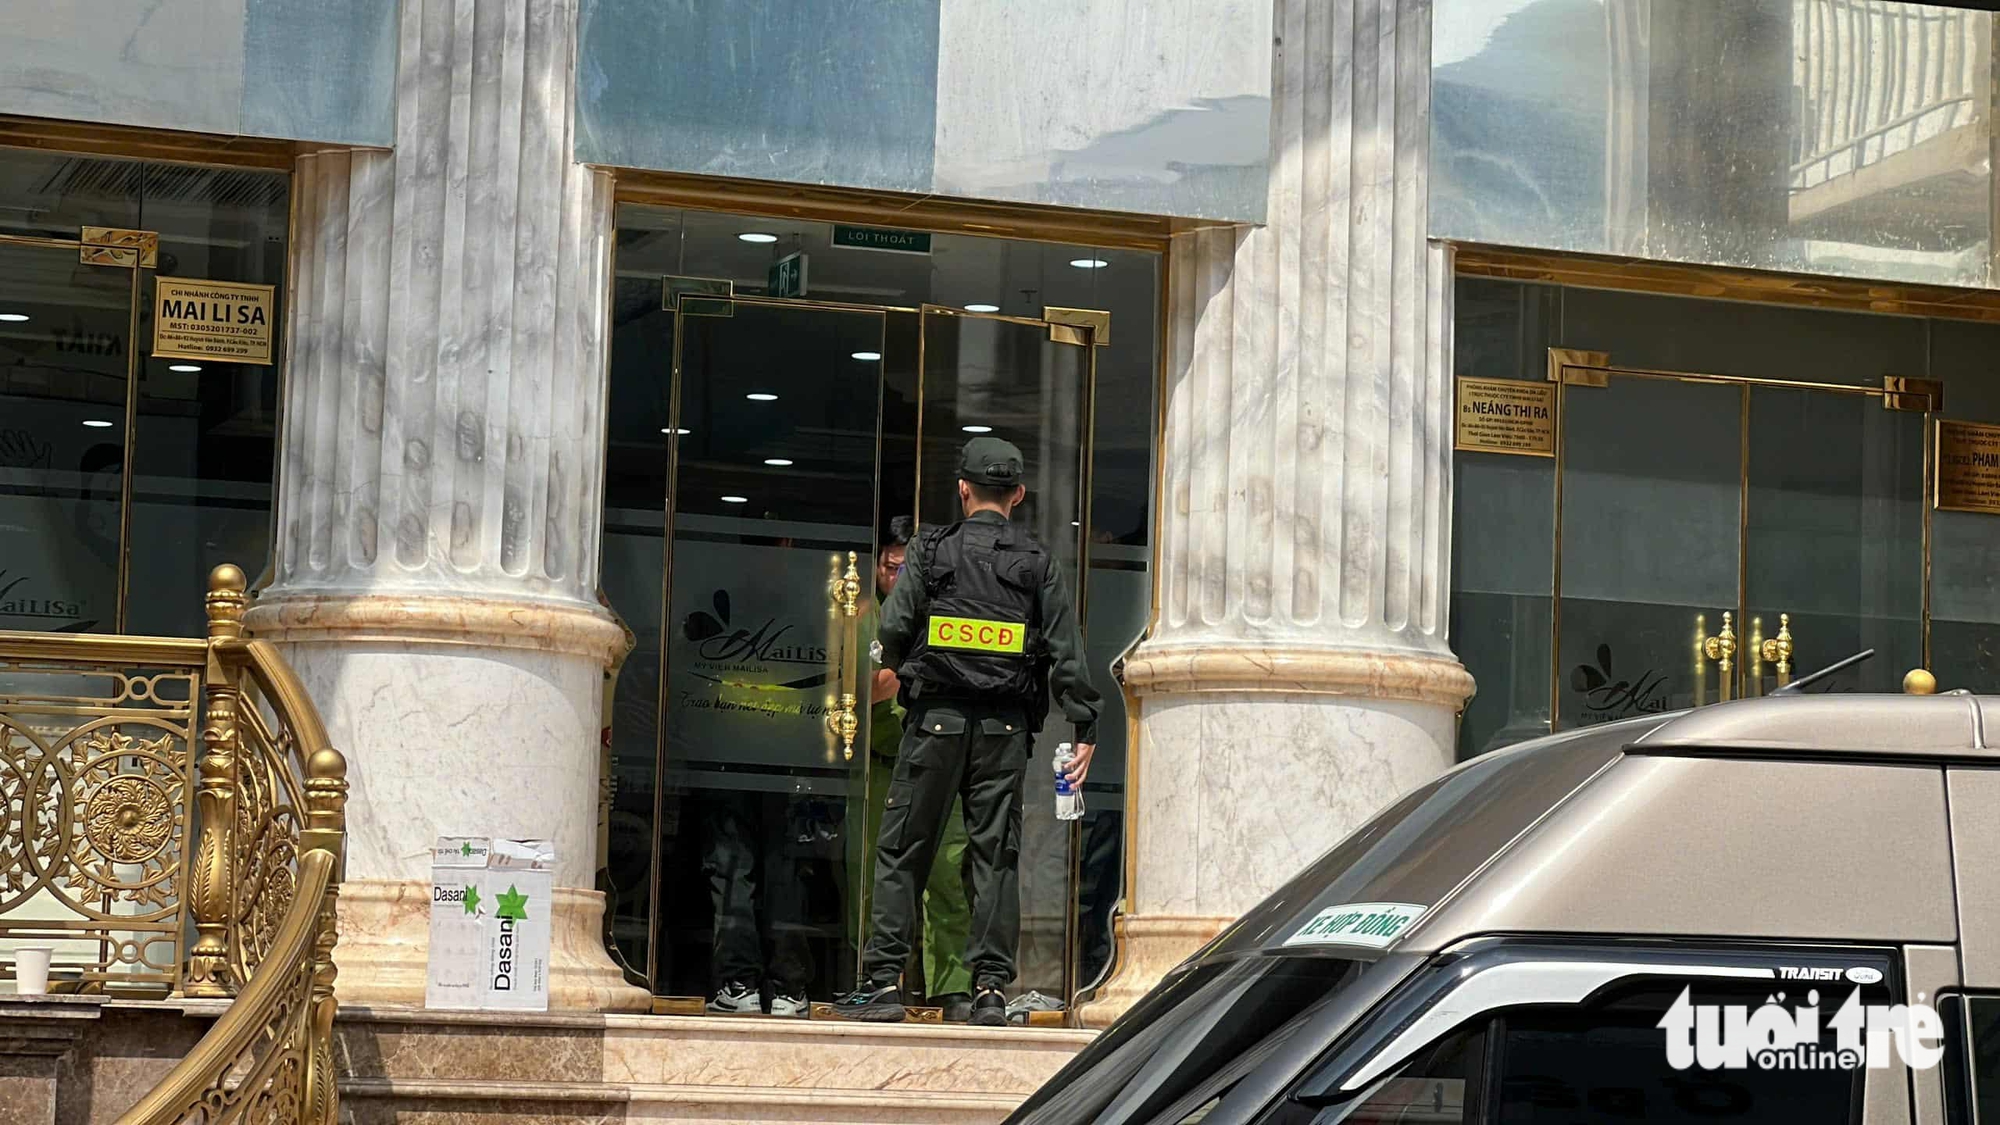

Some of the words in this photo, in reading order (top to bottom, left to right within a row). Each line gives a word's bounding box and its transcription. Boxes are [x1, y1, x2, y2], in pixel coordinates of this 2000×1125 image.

[170, 289, 183, 297] CHI
[184, 289, 210, 299] NHÁNH
[210, 291, 230, 300] CÔNG
[162, 299, 206, 321] MAI
[213, 303, 231, 322] LI
[237, 305, 266, 326] SA
[170, 322, 190, 331] MST:
[1472, 400, 1511, 417] NEÁNG
[1534, 407, 1548, 419] RA
[699, 618, 836, 664] MaiLiS
[938, 622, 1013, 646] CSCĐ
[433, 886, 468, 902] Dasani
[1297, 914, 1332, 936] XE
[494, 914, 513, 991] Dasani
[1779, 966, 1844, 981] TRANSIT
